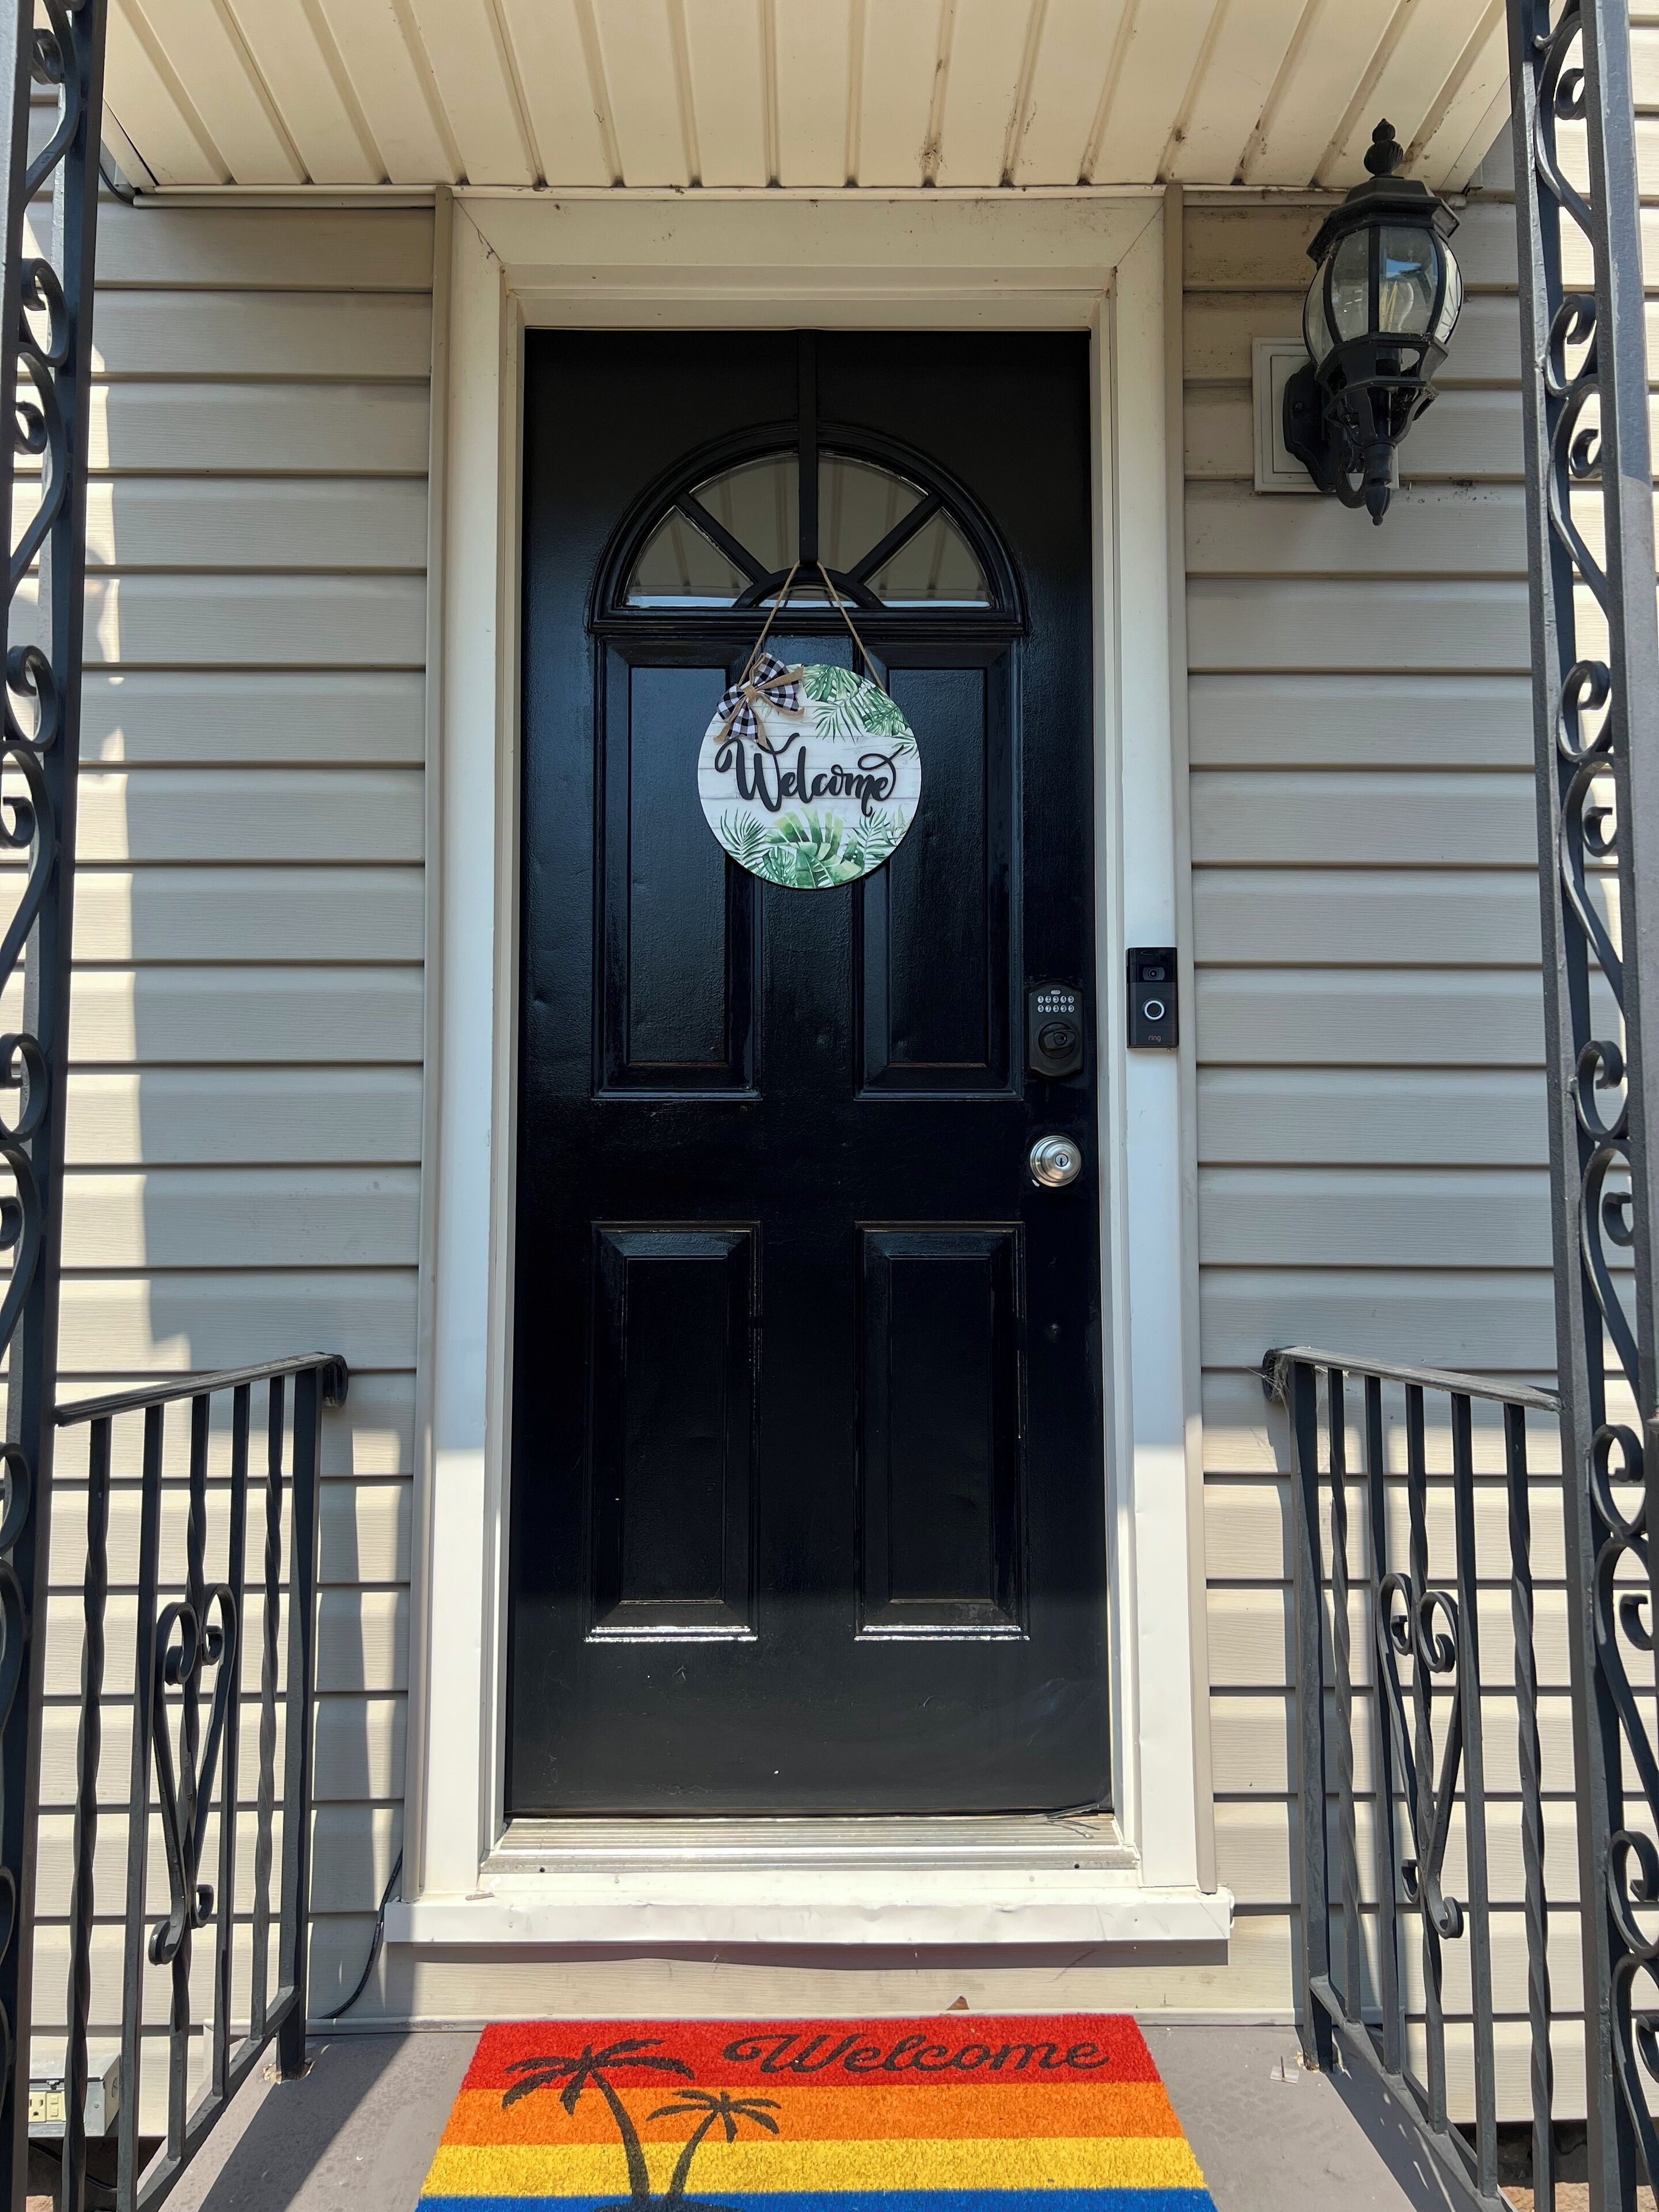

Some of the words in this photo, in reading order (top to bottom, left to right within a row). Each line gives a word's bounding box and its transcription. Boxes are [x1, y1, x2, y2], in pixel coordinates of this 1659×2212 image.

[714, 732, 904, 817] Welcome
[1148, 1034, 1161, 1043] ring
[722, 2033, 1109, 2074] Welcome
